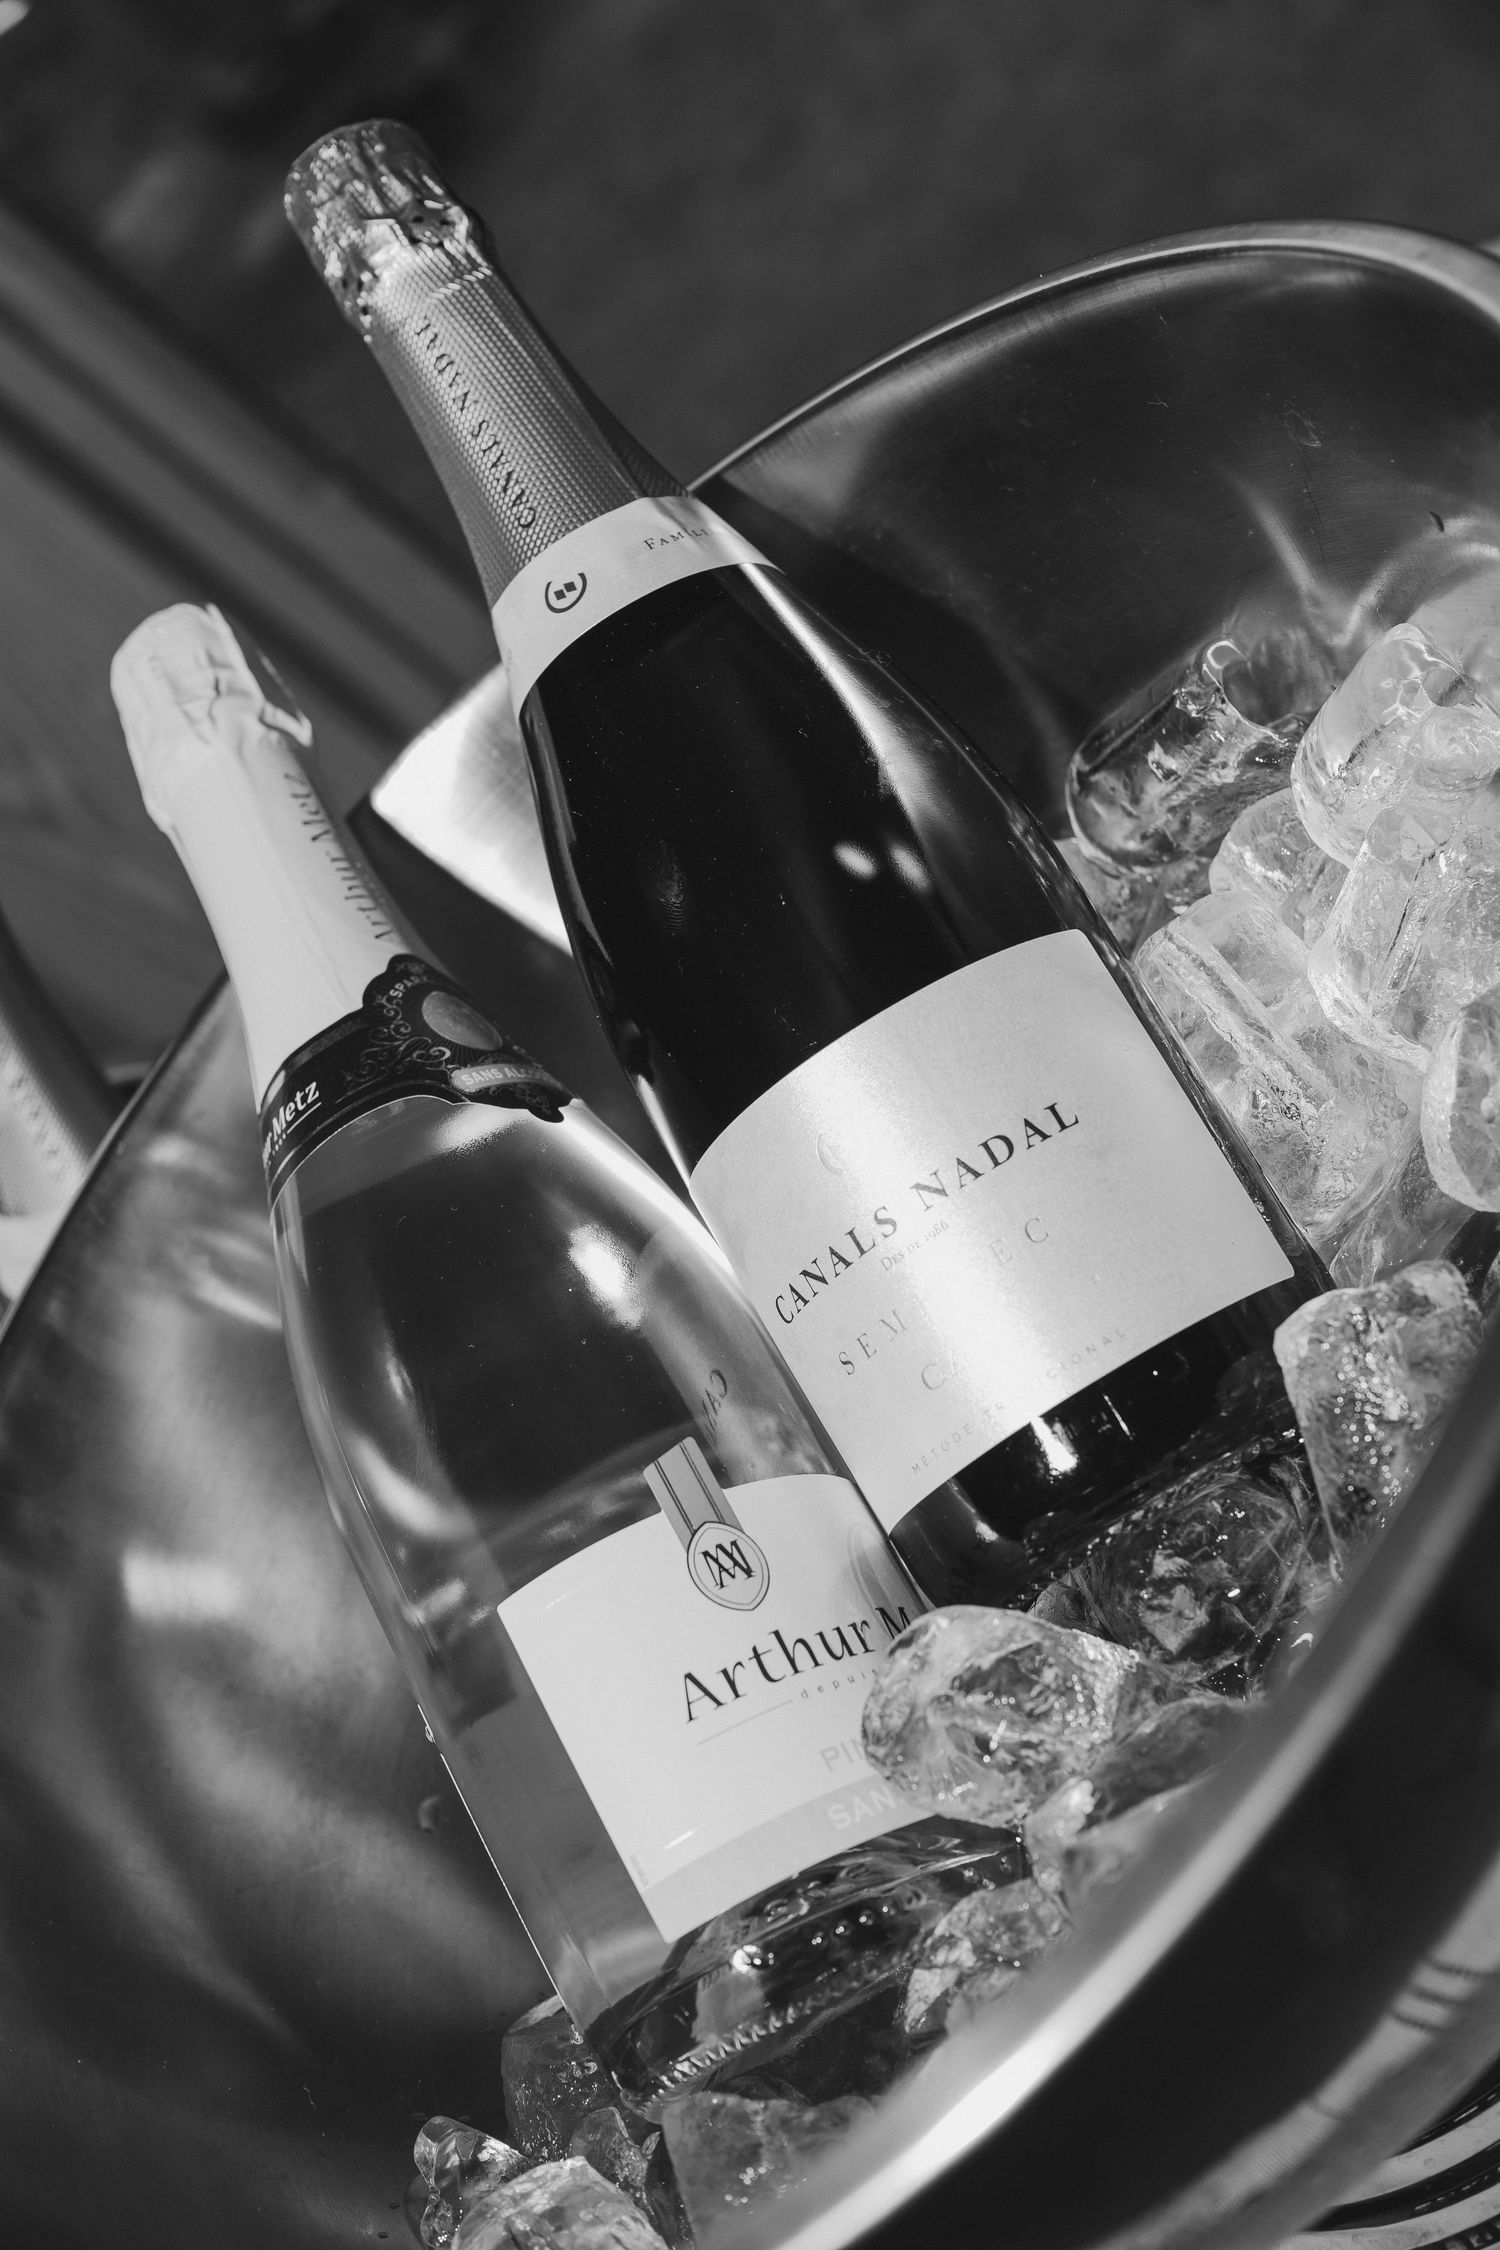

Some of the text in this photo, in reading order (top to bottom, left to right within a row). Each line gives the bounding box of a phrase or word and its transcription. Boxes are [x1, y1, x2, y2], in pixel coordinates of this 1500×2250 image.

[471, 420, 536, 528] CANALS
[643, 527, 709, 550] FAMILI
[460, 1064, 502, 1085] SANS
[775, 1102, 1080, 1325] CANALS NADAL
[837, 1308, 908, 1376] SEM
[682, 1618, 876, 1724] Arthur
[827, 1784, 900, 1831] SAN
